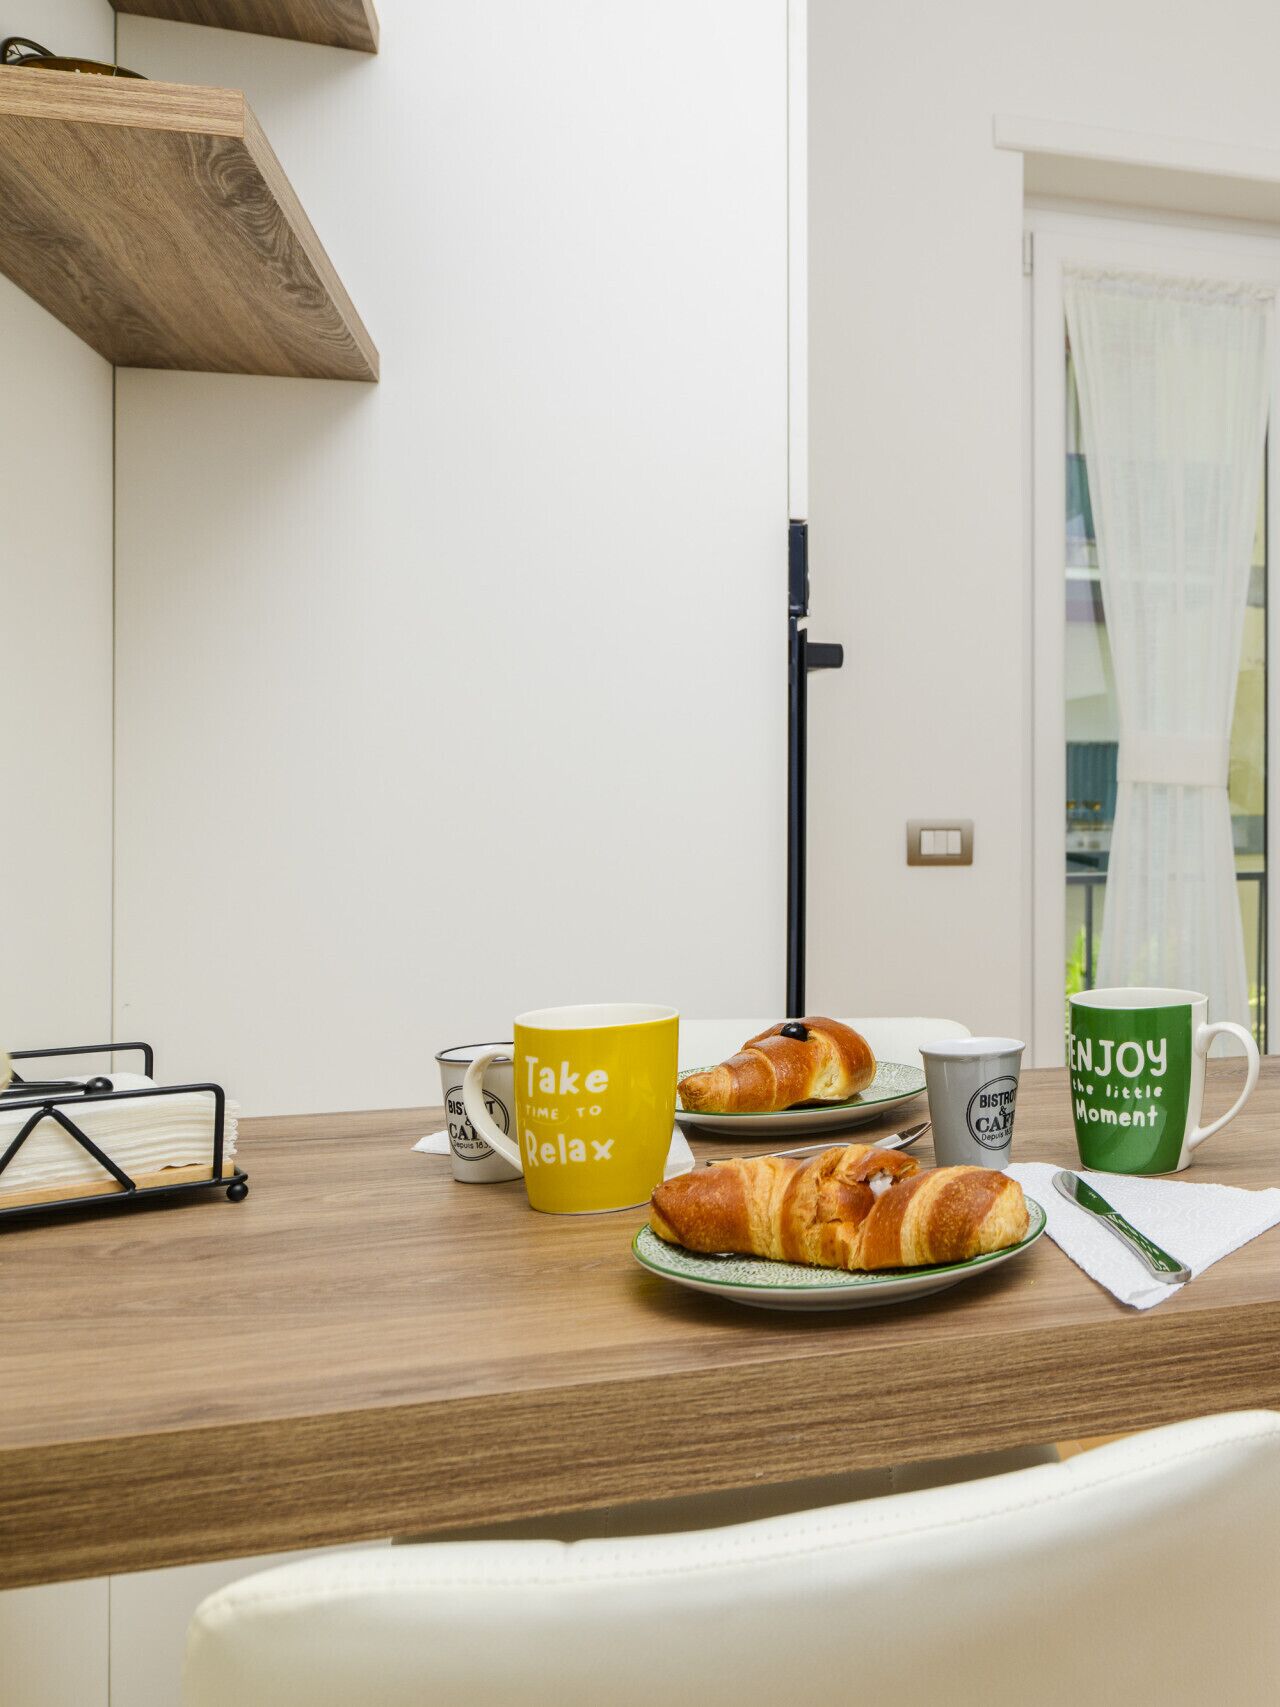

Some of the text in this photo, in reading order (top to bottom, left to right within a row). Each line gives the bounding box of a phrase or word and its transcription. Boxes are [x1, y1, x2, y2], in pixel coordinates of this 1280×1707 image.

[1070, 1033, 1167, 1077] ENJOY
[524, 1055, 609, 1097] Take
[1072, 1078, 1094, 1095] the
[980, 1088, 1017, 1108] BISTRO
[1106, 1083, 1163, 1099] little
[525, 1104, 602, 1120] TIME TO
[1076, 1099, 1158, 1127] Moment
[525, 1129, 615, 1167] Relax
